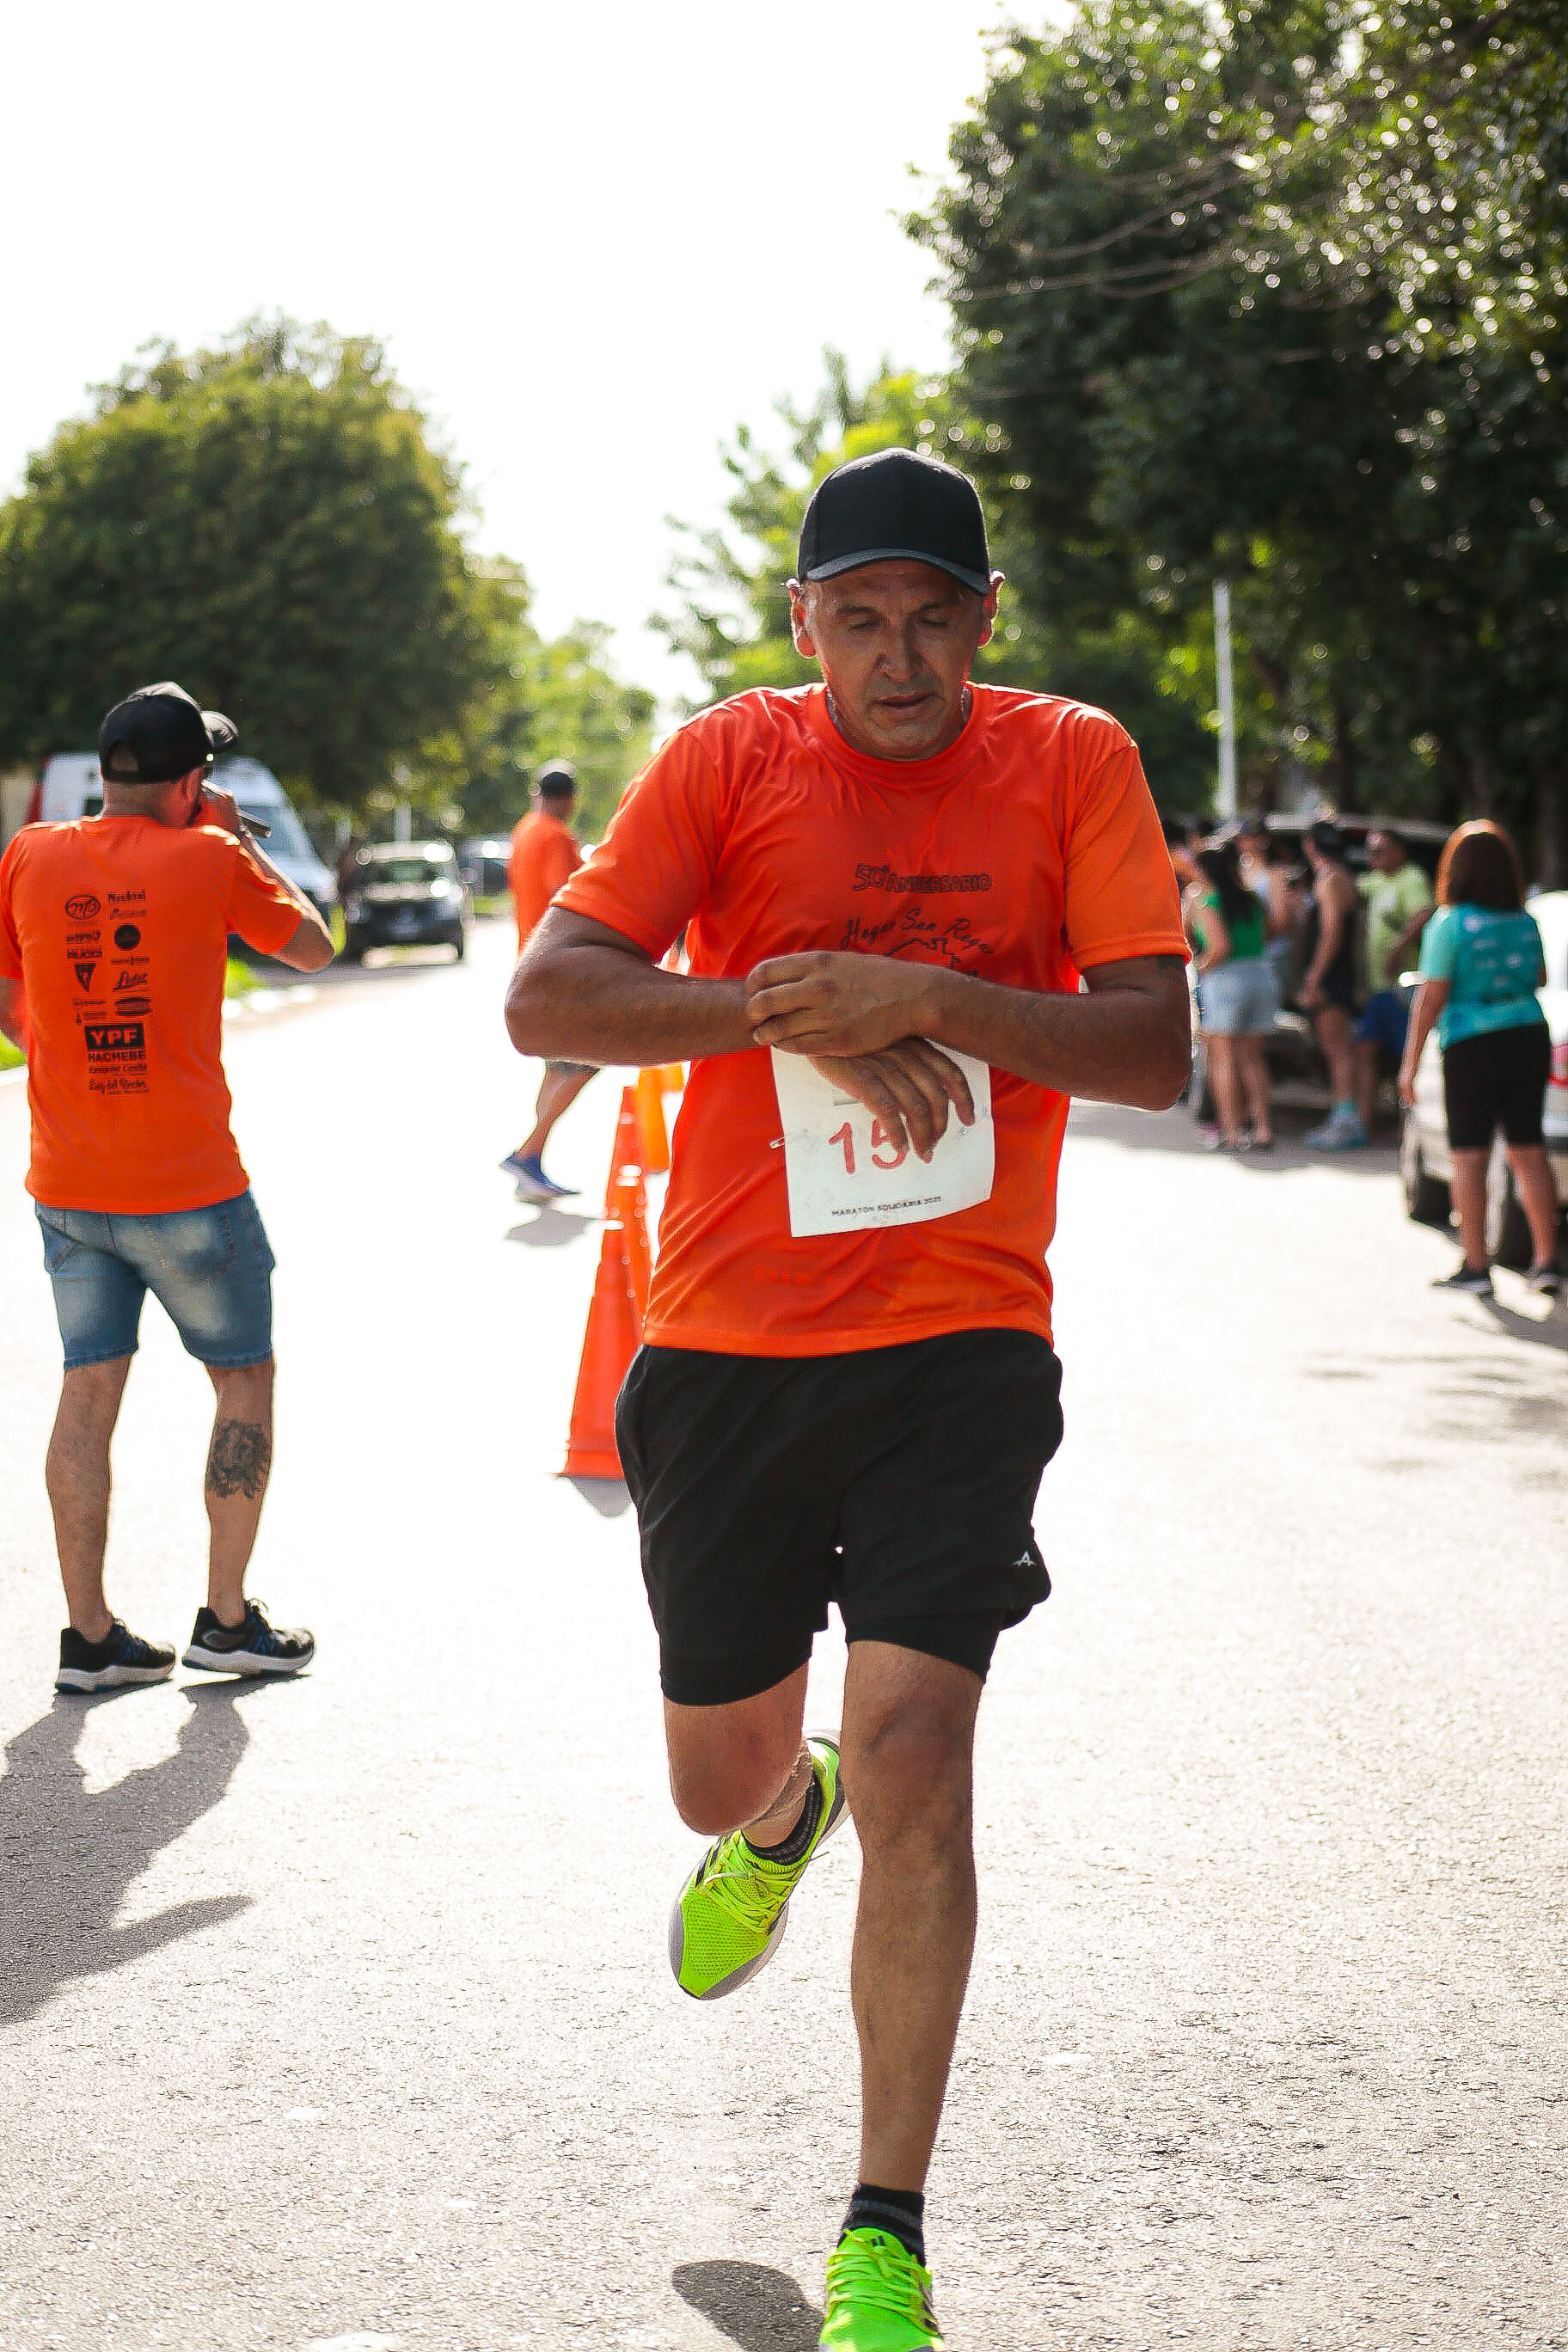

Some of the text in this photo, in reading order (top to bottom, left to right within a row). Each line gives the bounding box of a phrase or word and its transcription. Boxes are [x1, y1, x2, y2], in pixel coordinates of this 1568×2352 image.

[900, 907, 938, 931] San
[90, 1028, 137, 1046] YPF
[829, 1116, 934, 1175] 15
